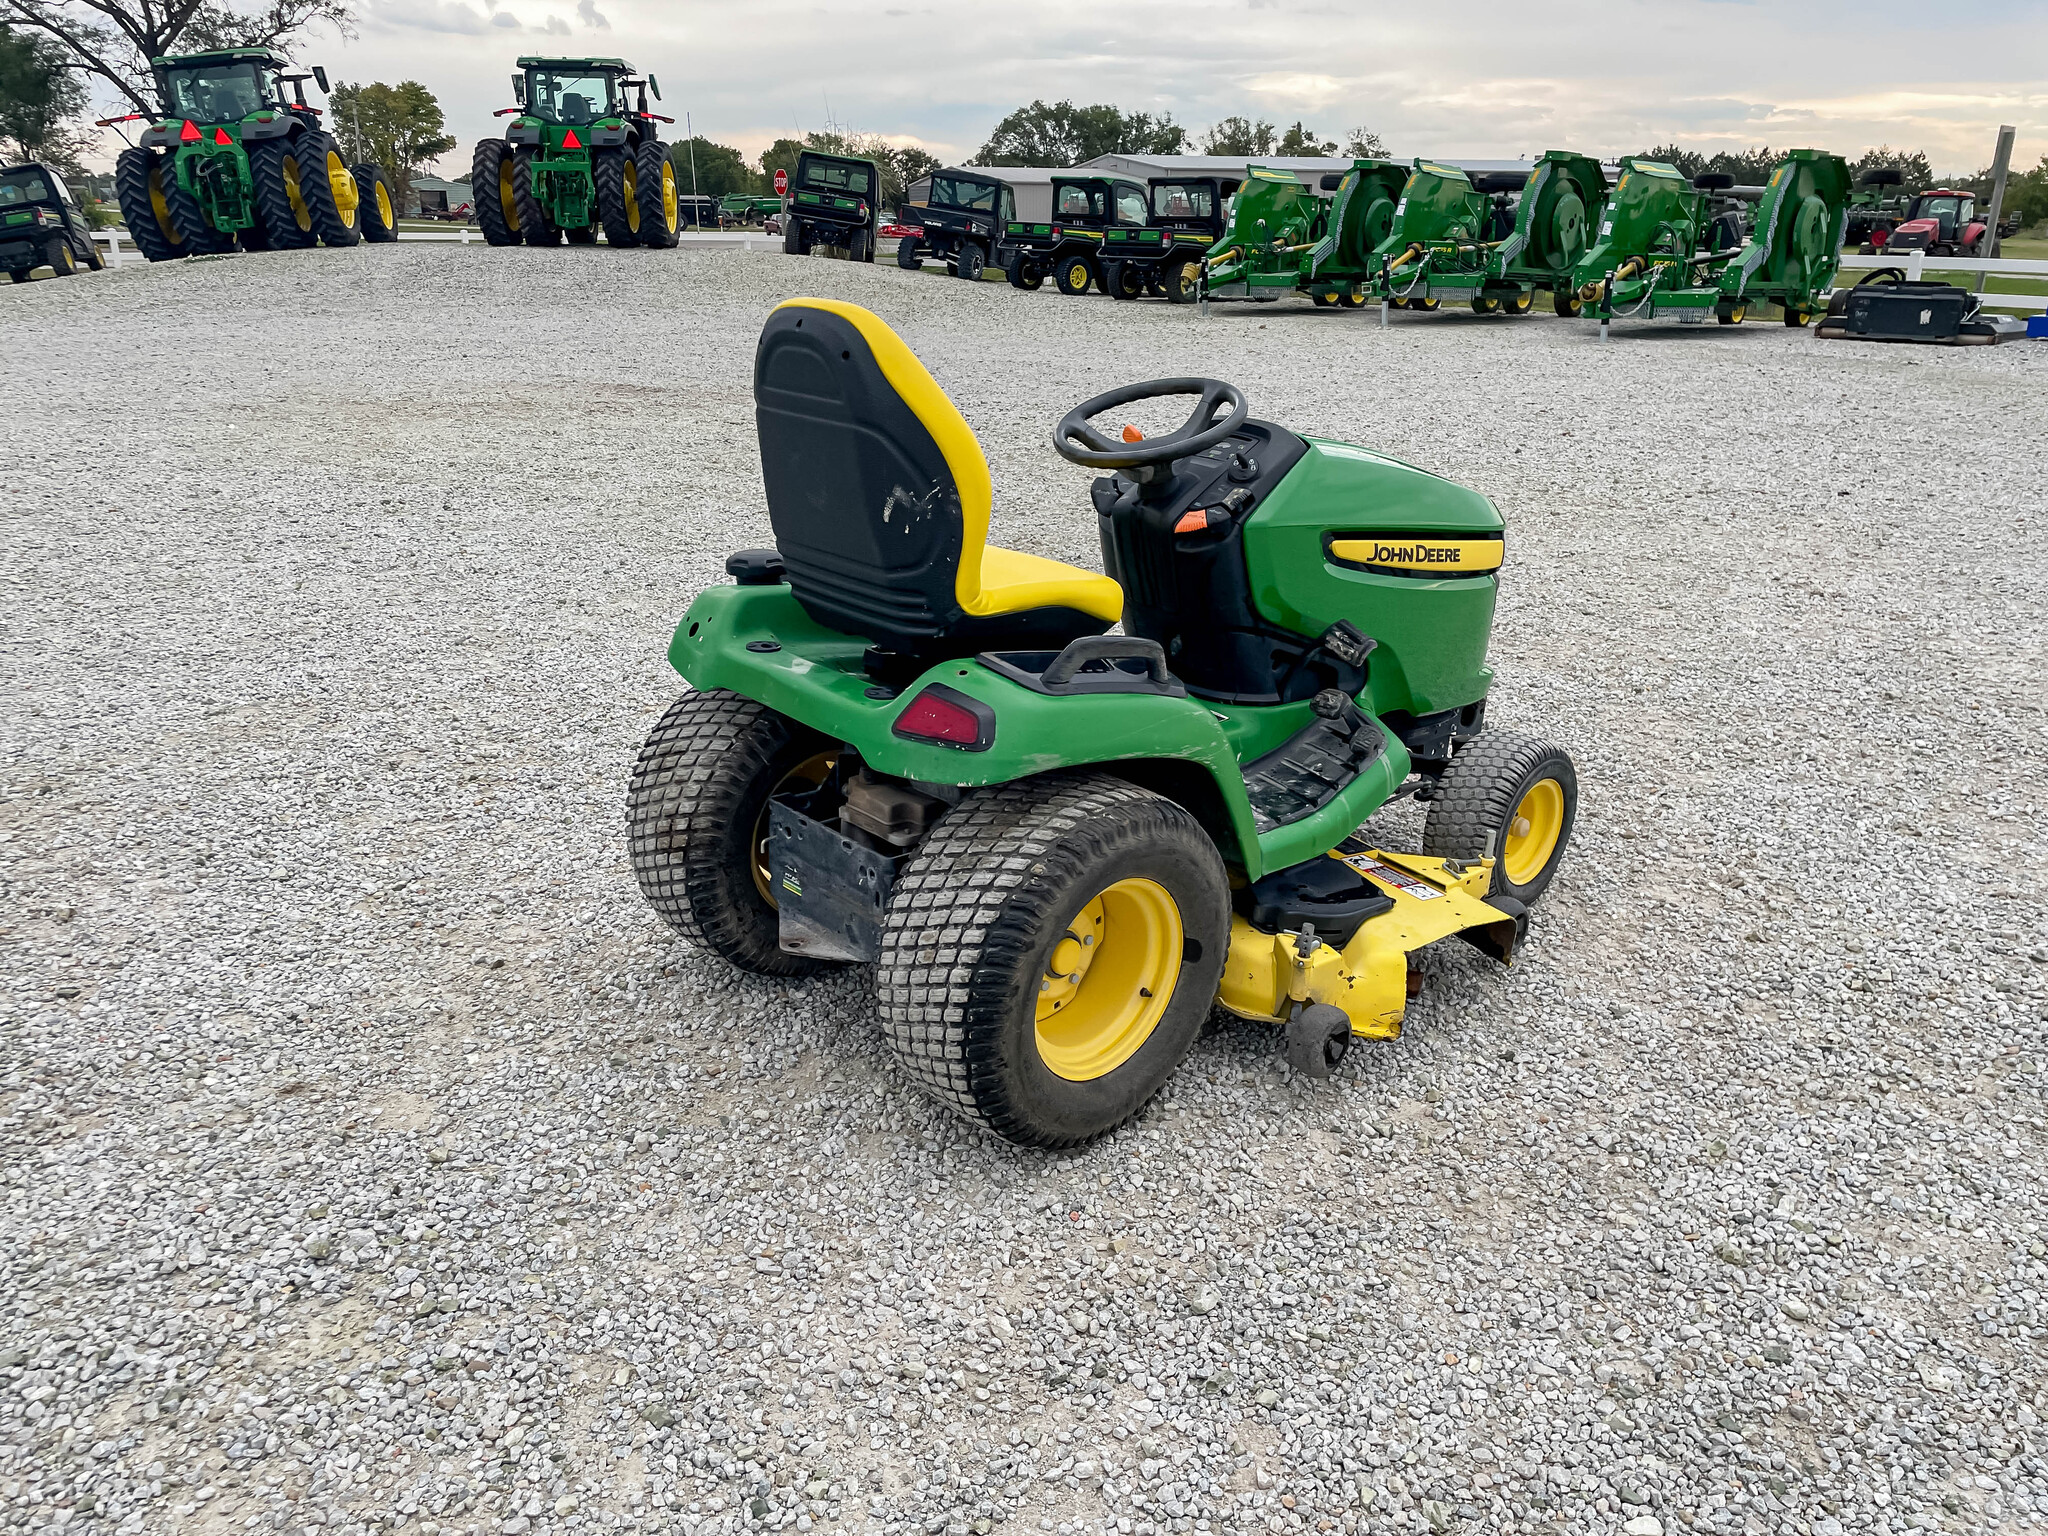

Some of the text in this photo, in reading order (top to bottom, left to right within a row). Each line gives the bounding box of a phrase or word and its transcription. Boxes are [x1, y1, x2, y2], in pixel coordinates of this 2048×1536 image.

[775, 177, 786, 187] STOP
[1366, 543, 1461, 563] JOHN DEERE
